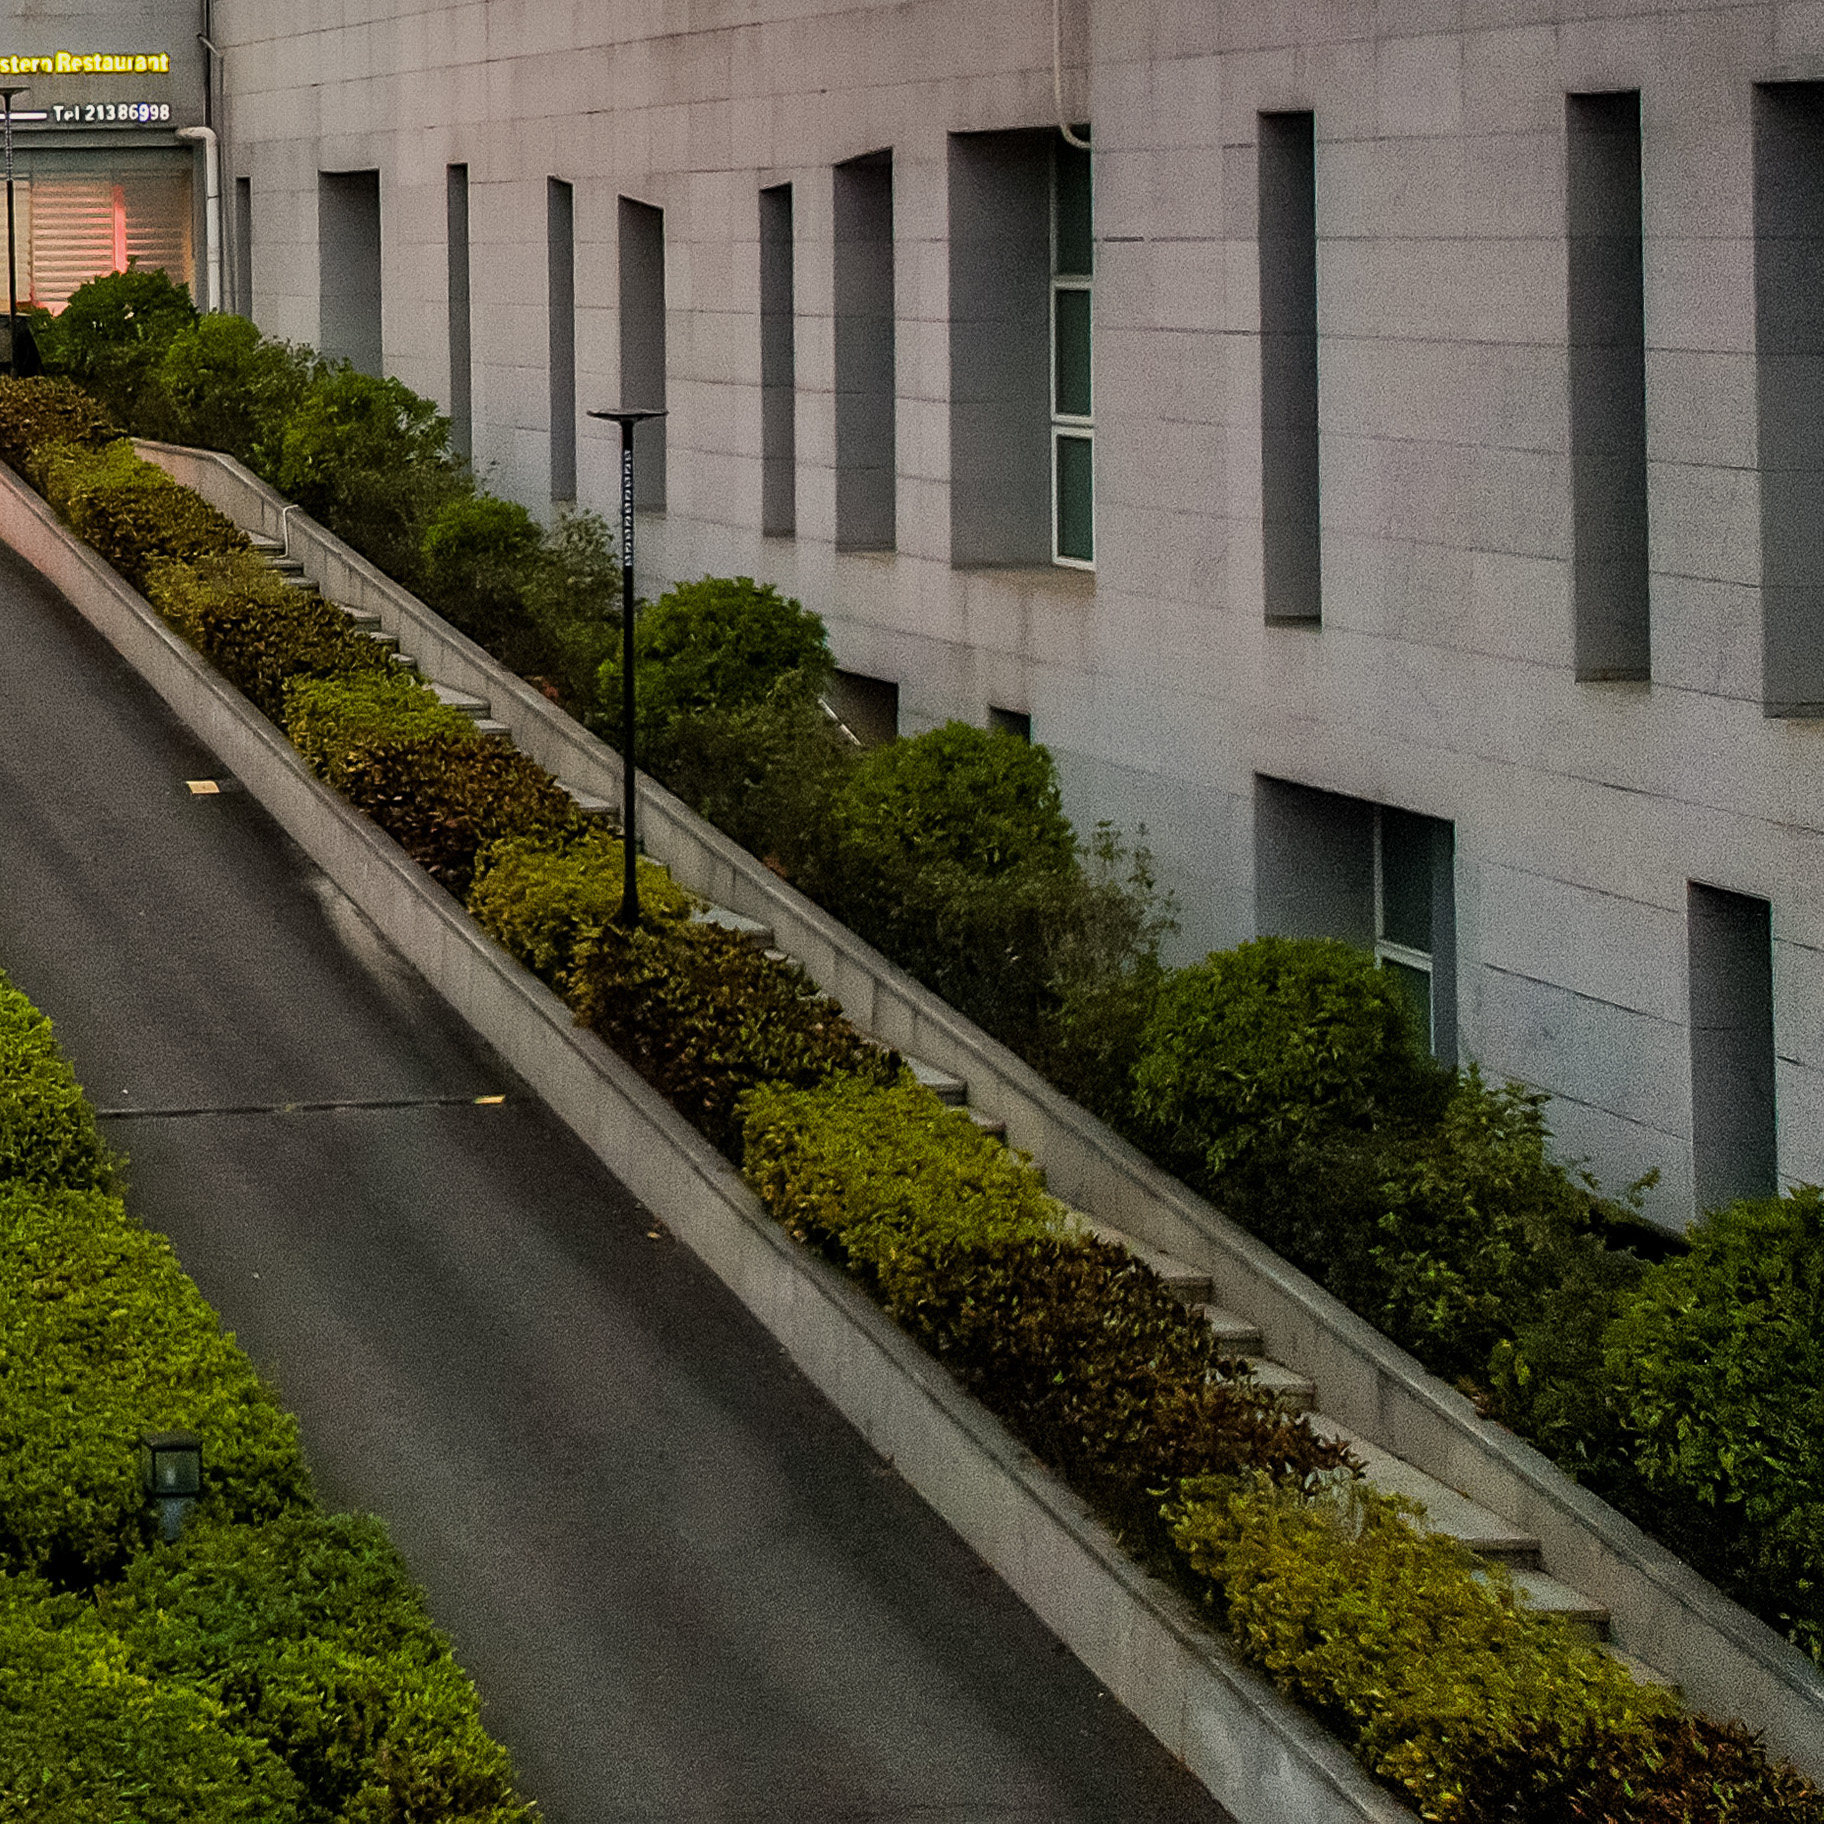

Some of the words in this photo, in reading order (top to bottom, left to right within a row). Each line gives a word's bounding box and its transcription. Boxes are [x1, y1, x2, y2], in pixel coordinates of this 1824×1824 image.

[54, 50, 170, 73] Restaurant
[53, 104, 81, 122] Tel
[84, 102, 170, 122] 21386998
